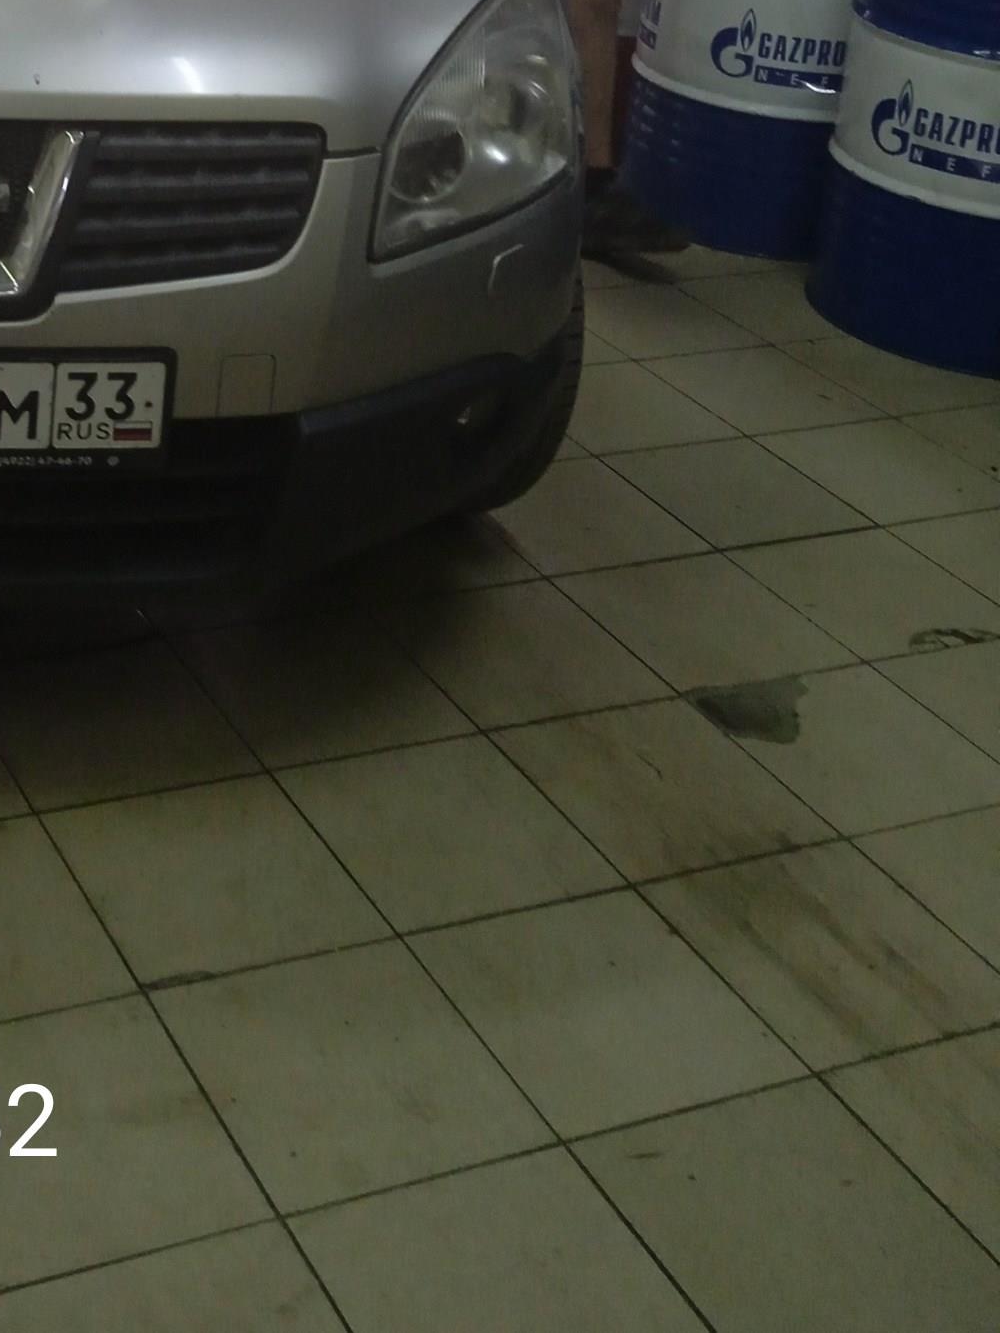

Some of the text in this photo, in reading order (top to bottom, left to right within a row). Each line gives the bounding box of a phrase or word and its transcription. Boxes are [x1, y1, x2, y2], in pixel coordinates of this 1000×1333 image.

[758, 32, 847, 67] GAZPRO
[757, 69, 830, 86] NEF
[913, 107, 1000, 155] GAZPR
[911, 147, 992, 179] NEF
[64, 372, 139, 422] 33
[57, 422, 111, 441] RUS
